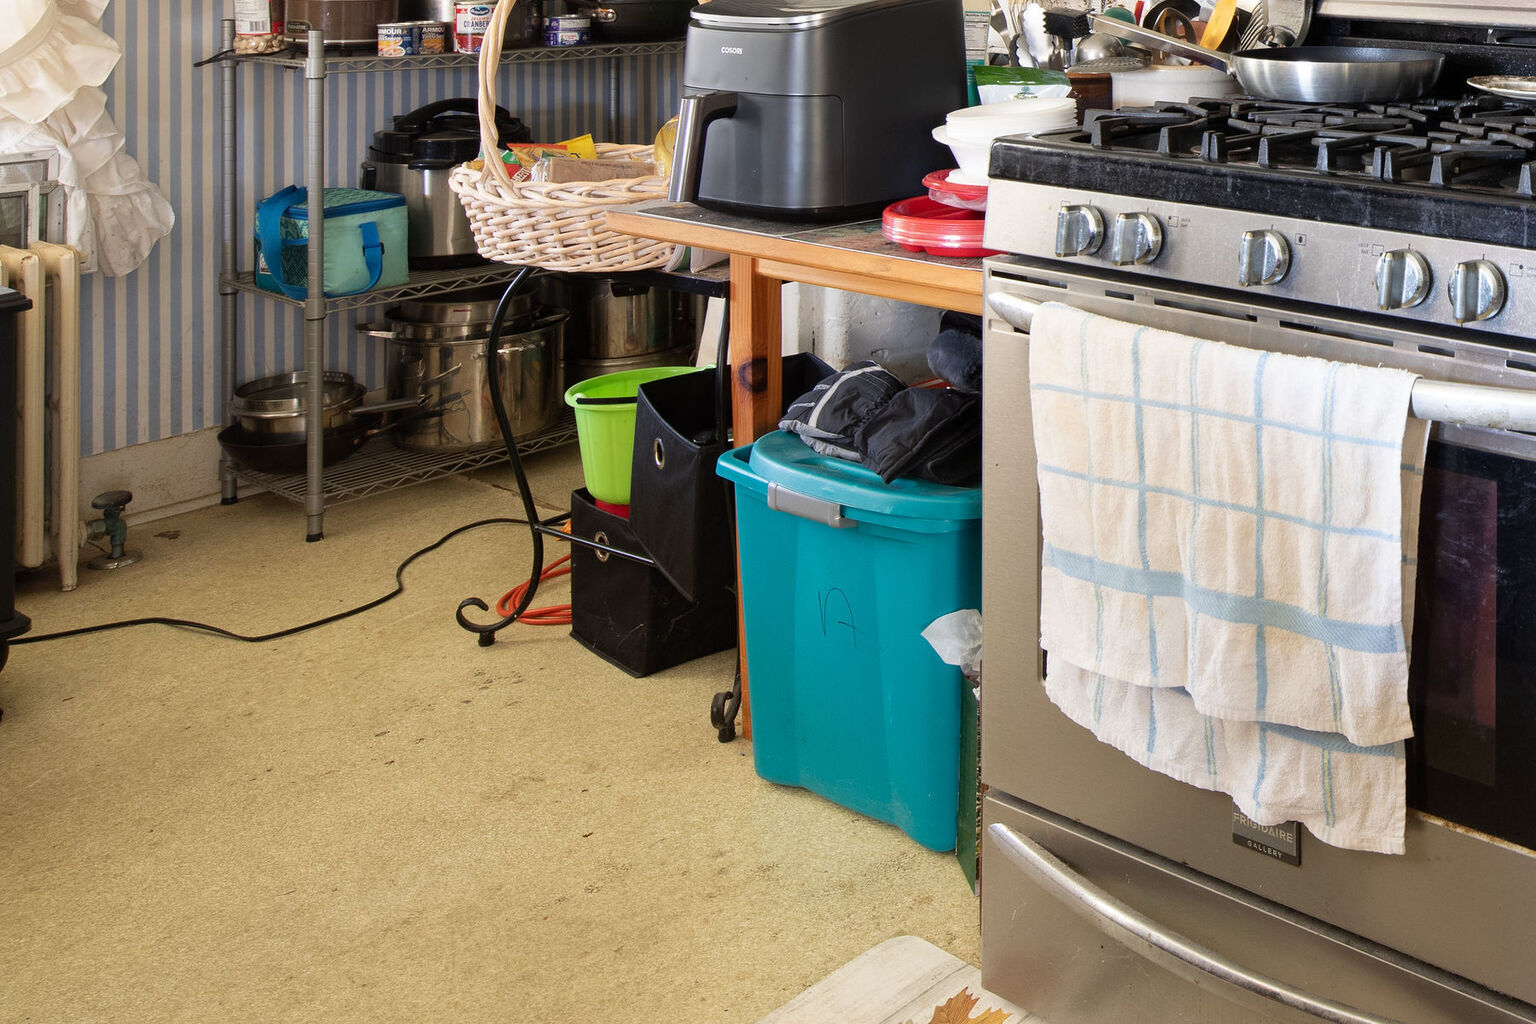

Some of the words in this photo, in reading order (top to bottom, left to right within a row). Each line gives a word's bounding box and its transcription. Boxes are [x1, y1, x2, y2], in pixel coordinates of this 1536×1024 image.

[721, 46, 743, 55] COSORI
[1232, 812, 1294, 844] FRIGIDAIRE
[1247, 840, 1282, 859] GALLERY
